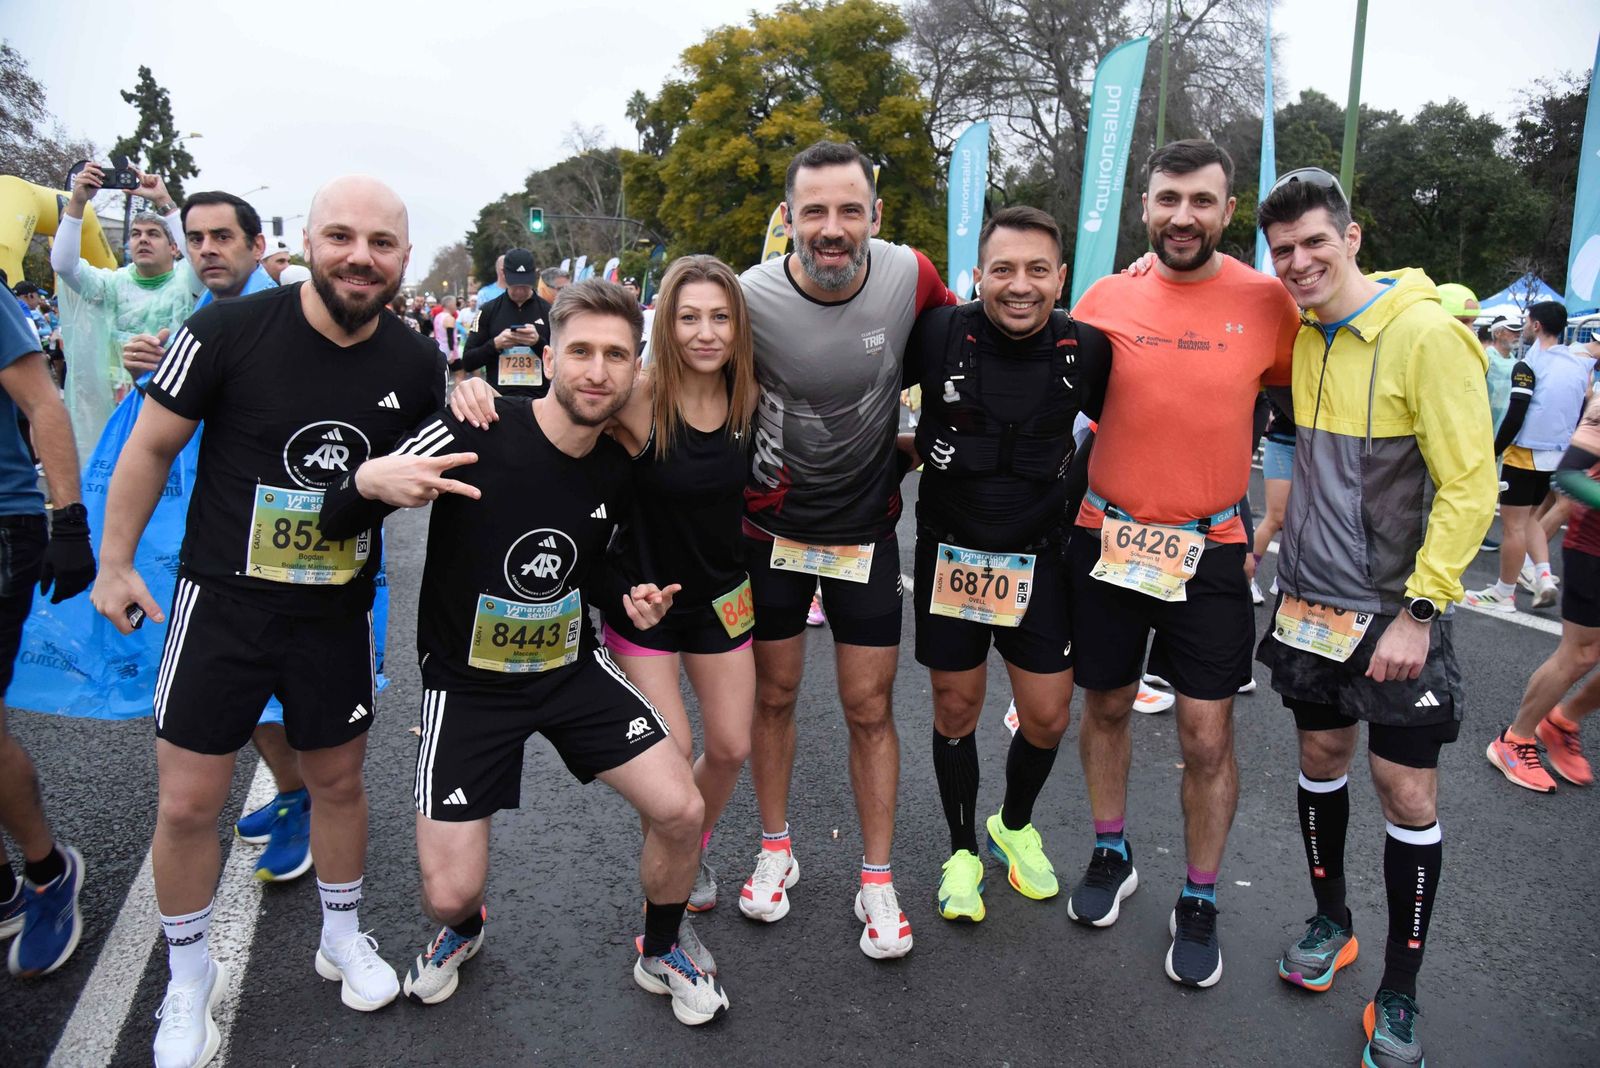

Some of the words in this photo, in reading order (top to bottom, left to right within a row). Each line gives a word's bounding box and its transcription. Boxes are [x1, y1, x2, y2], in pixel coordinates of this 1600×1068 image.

[862, 333, 885, 349] TRIB
[505, 356, 532, 368] 7283
[1116, 525, 1181, 559] 6426
[949, 568, 1009, 600] 6870
[491, 622, 561, 649] 8443
[1412, 865, 1425, 937] COMPRESSPORT
